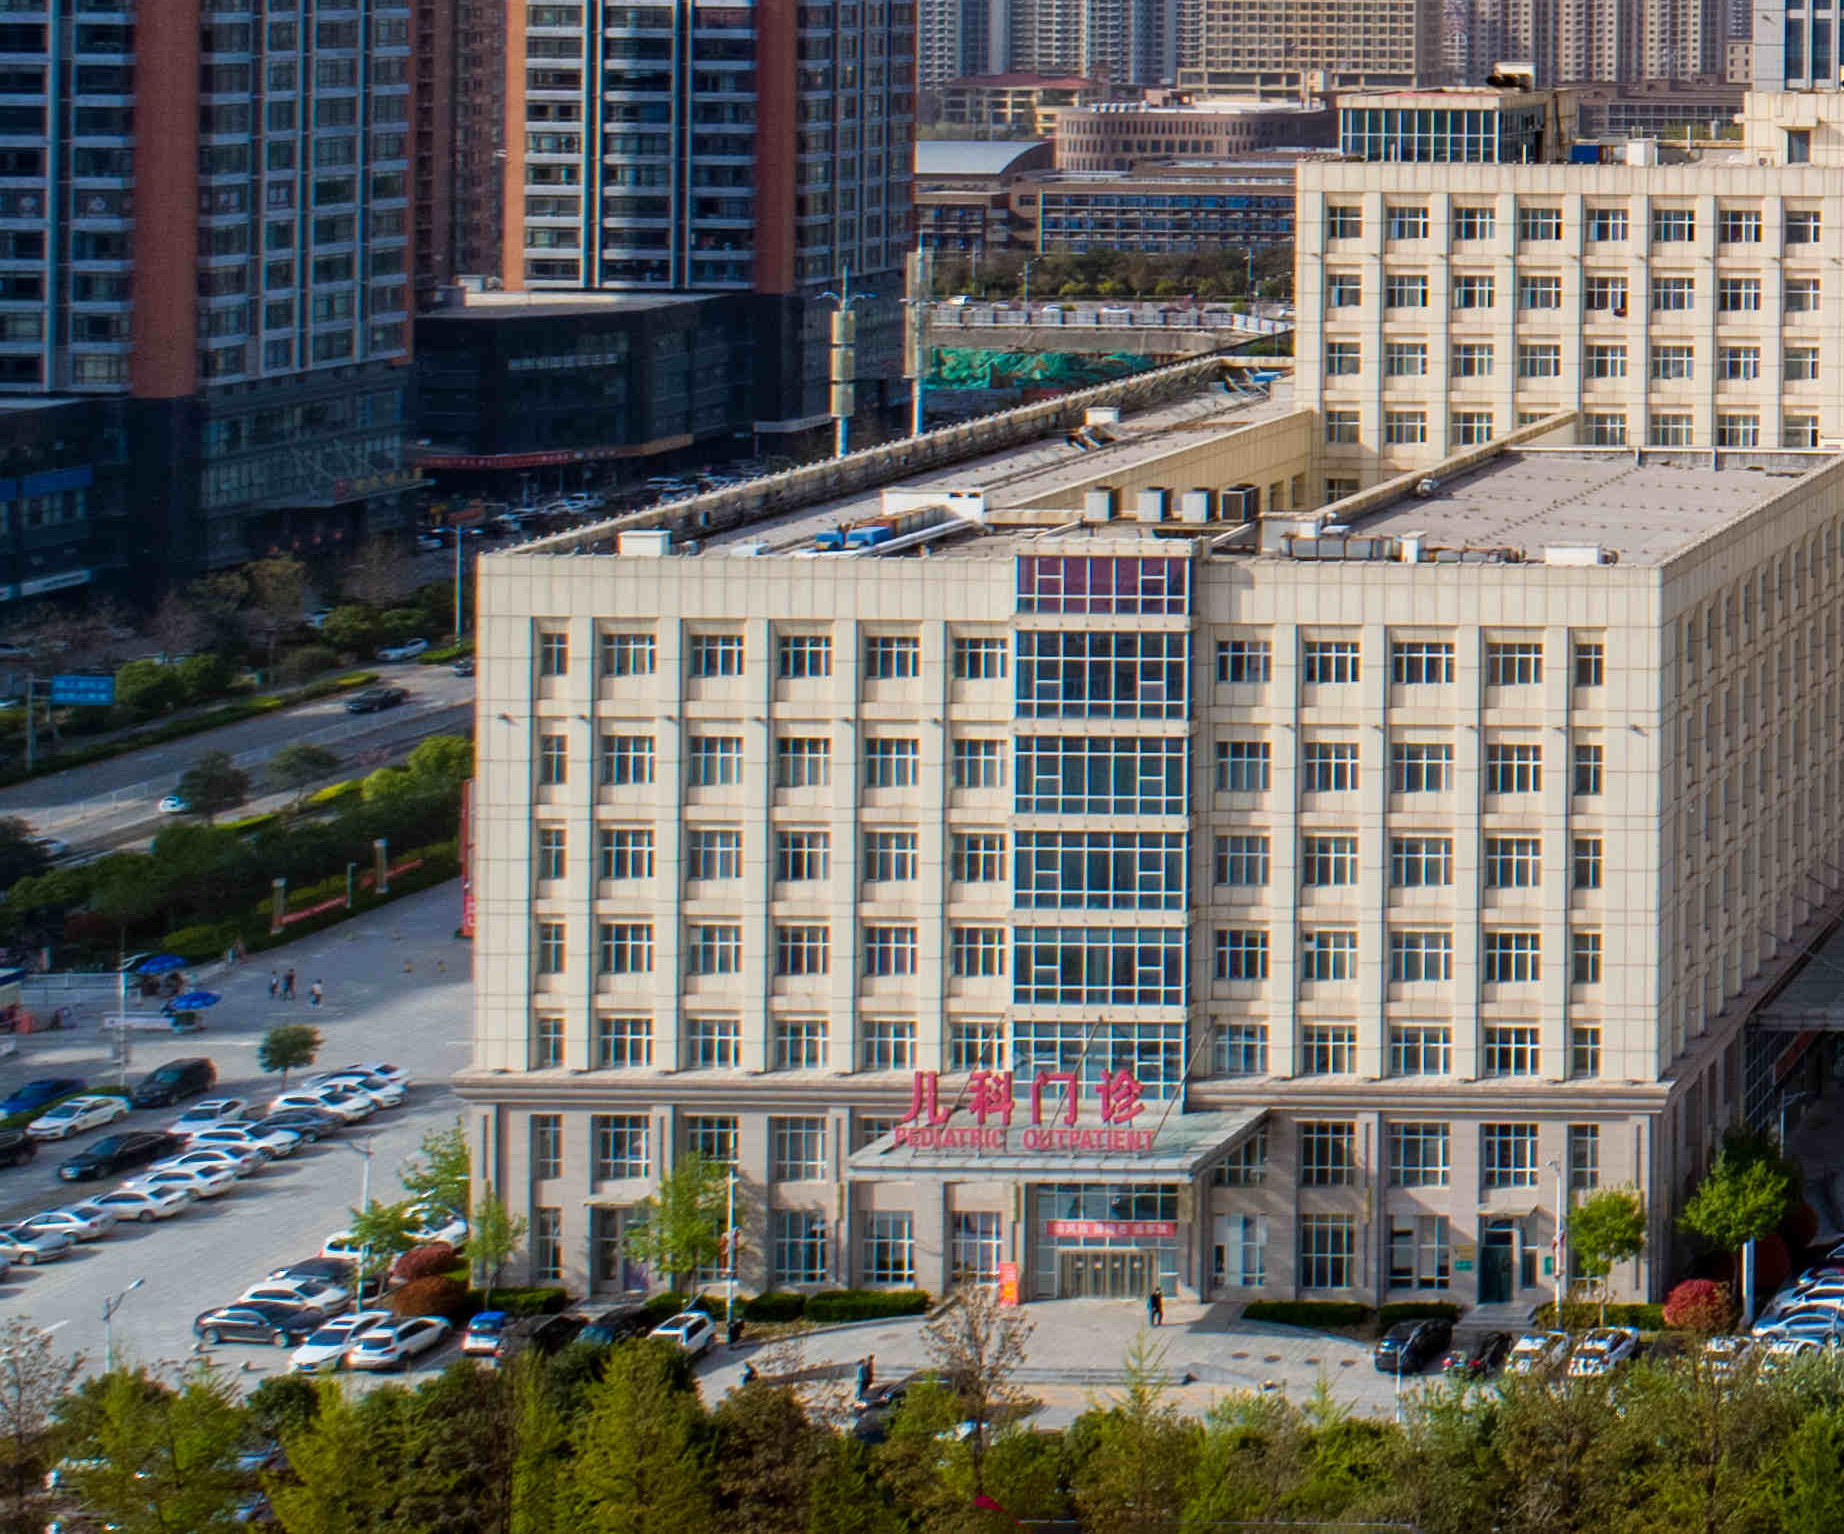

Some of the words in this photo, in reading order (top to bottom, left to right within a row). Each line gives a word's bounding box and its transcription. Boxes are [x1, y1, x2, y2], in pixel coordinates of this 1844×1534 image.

[903, 1068, 1146, 1126] 儿科门诊
[894, 1126, 1005, 1149] PEDIATRIC
[1022, 1128, 1155, 1151] OUTPATIENT
